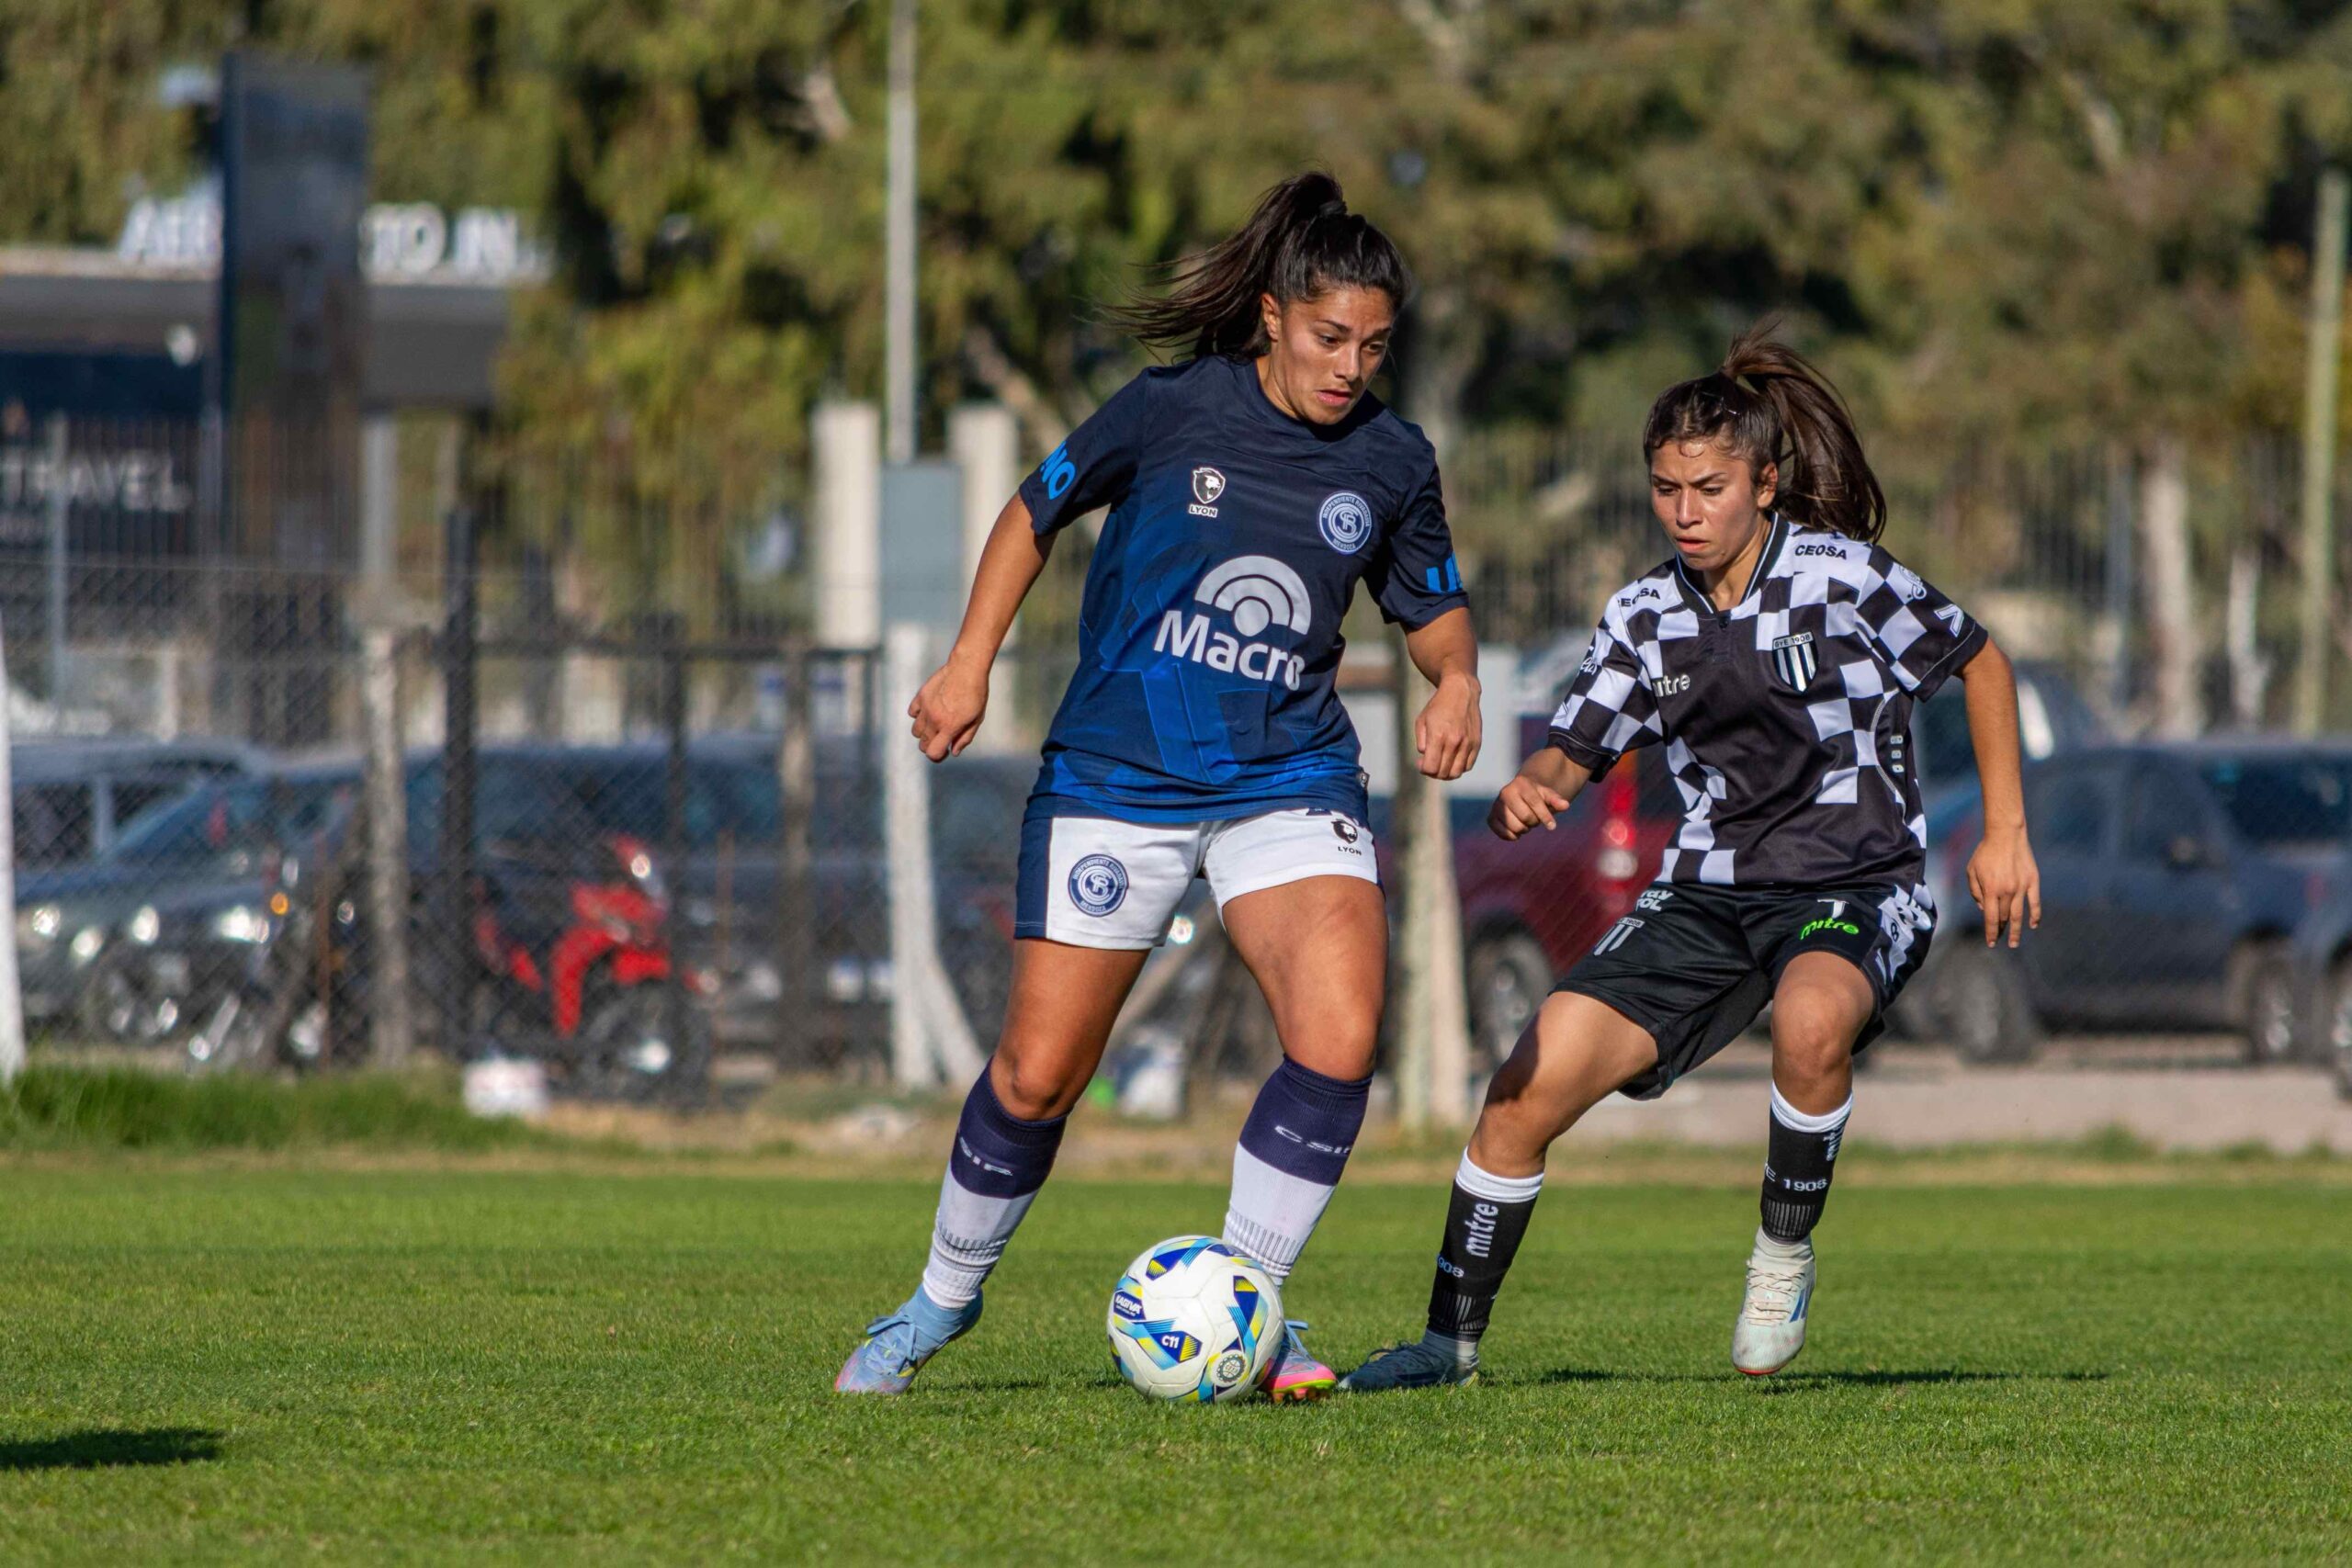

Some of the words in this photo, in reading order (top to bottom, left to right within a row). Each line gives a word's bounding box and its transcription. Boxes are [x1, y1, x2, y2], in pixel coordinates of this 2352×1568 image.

[1189, 504, 1217, 517] LYON
[1794, 544, 1848, 560] CEOSA
[1792, 633, 1812, 645] 1908
[1153, 610, 1306, 691] Macro
[1337, 846, 1363, 856] LYON
[1464, 1202, 1499, 1258] mitre
[1161, 1335, 1181, 1349] C11
